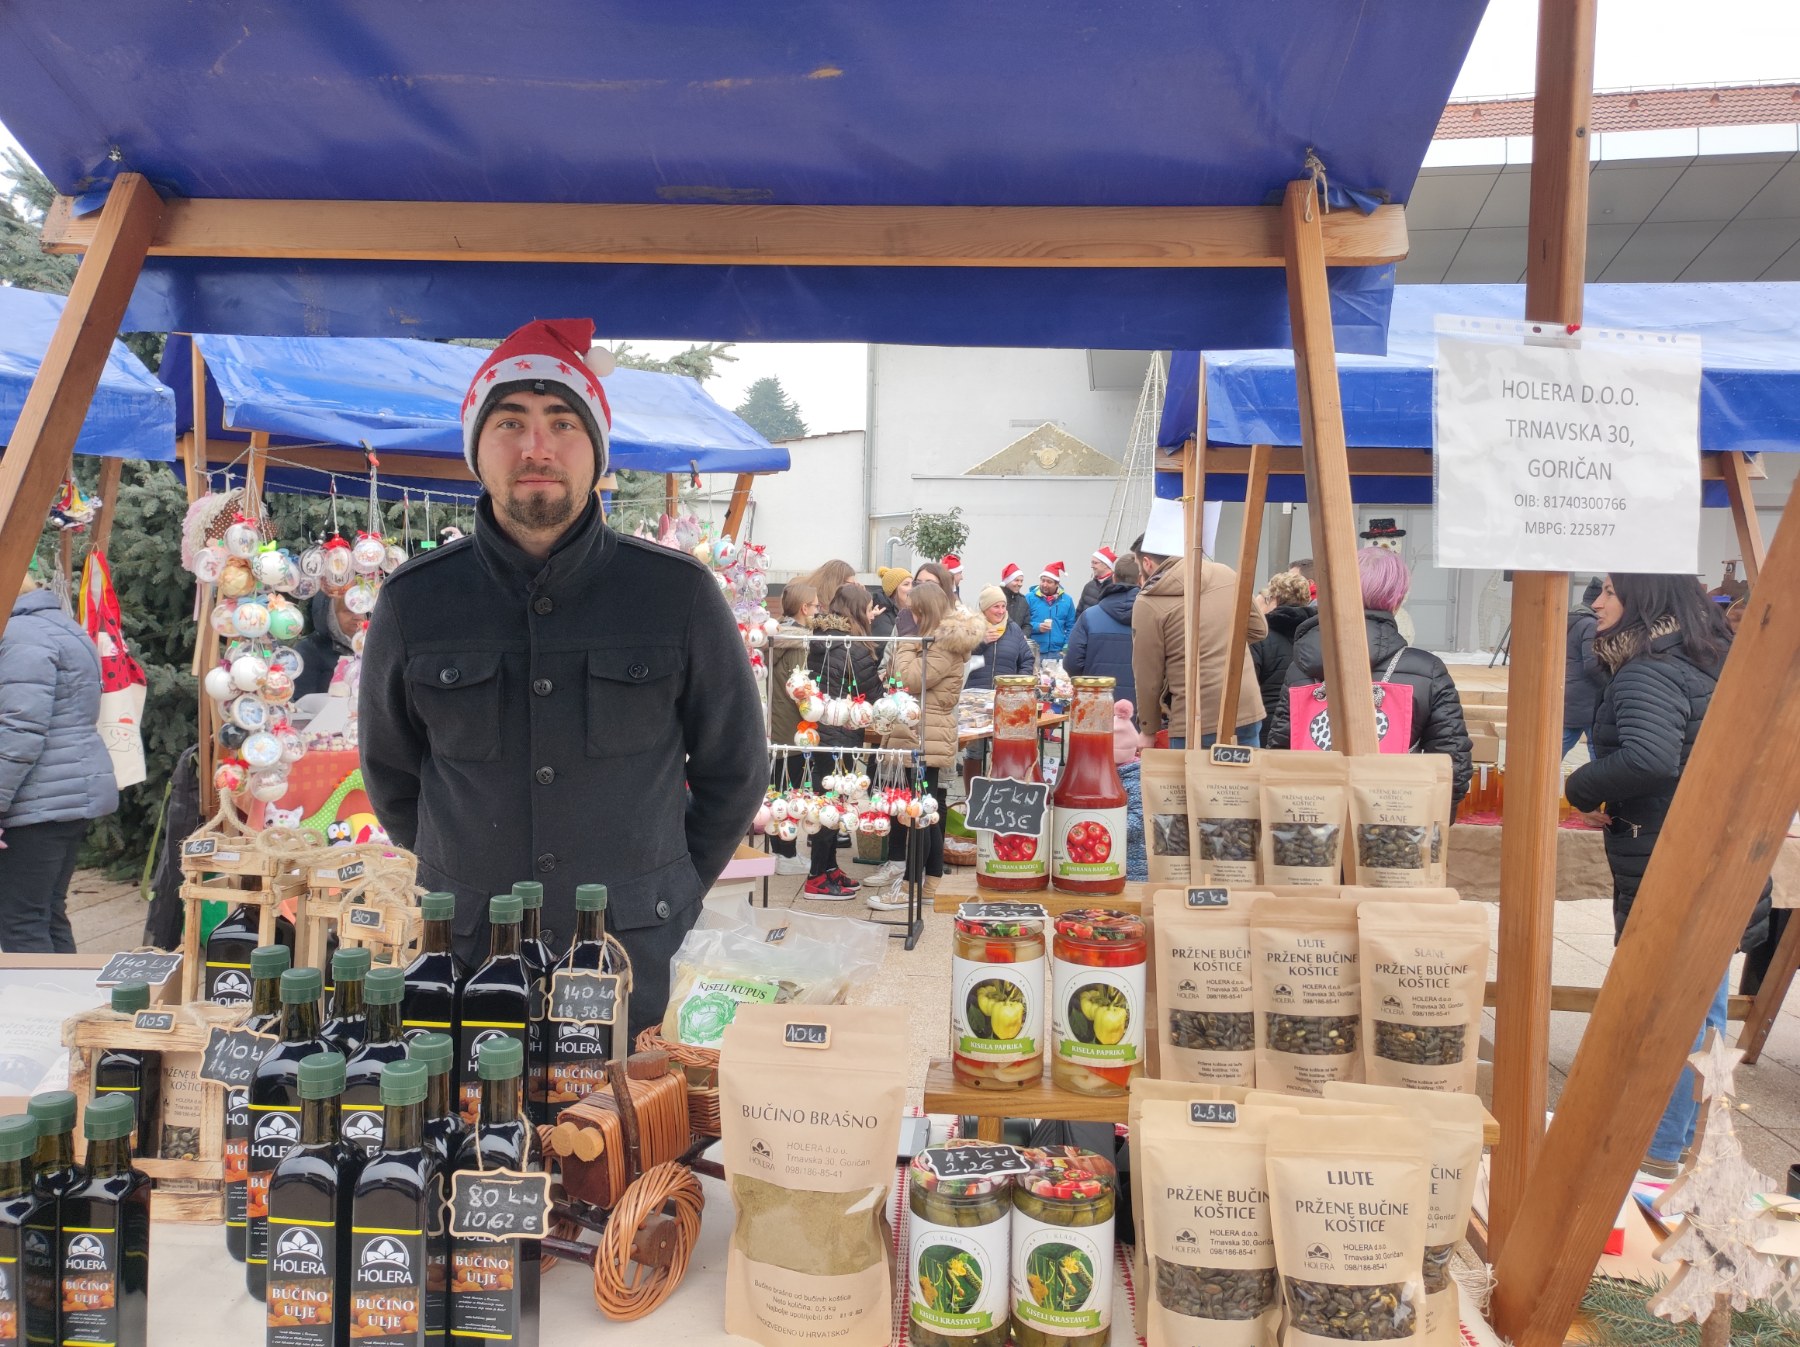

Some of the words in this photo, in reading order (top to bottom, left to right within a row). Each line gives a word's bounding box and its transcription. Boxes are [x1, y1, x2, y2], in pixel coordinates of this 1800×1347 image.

[1502, 380, 1574, 402] HOLERA
[1582, 384, 1639, 406] D.O.O.
[1505, 419, 1602, 442] TRNAVSKA
[1608, 425, 1634, 447] 30,
[1528, 457, 1612, 480] GORIČAN
[1514, 494, 1540, 508] OIB:
[1543, 496, 1626, 511] 81740300766
[1525, 521, 1566, 536] MBPG:
[1570, 522, 1615, 536] 225877
[1292, 814, 1319, 822] LJUTE
[1380, 814, 1407, 824] SLANE
[341, 863, 363, 878] 120
[1190, 892, 1204, 904] 15
[352, 911, 371, 924] 80
[1297, 939, 1326, 948] LJUTE
[1172, 947, 1216, 959] PRŽENE
[1220, 948, 1252, 960] BUČIN
[1267, 952, 1312, 963] PRŽENE
[1316, 951, 1358, 964] BUČINE
[1415, 948, 1445, 959] SLANE
[115, 957, 147, 968] 140
[1194, 961, 1242, 972] KOŠTICE
[1376, 962, 1422, 975] PRŽENE
[1426, 963, 1468, 975] BUČINE
[1289, 966, 1339, 976] KOŠTICE
[1398, 976, 1450, 988] KOŠTICE
[564, 984, 594, 1000] 140
[730, 984, 768, 1000] KUPUS
[138, 1014, 168, 1028] 105
[786, 1025, 806, 1041] 10
[215, 1037, 248, 1059] 110
[556, 1042, 602, 1054] HOLERA
[970, 1042, 994, 1050] KISELA
[995, 1042, 1022, 1050] PAPRIKA
[1072, 1046, 1095, 1055] KISELA
[1096, 1048, 1125, 1056] PAPRIKA
[554, 1065, 604, 1080] BUČINO
[565, 1081, 593, 1094] ULJE
[742, 1102, 805, 1124] BUČINO
[810, 1110, 878, 1130] BRAŠNO
[787, 1142, 823, 1152] HOLERA
[749, 1156, 776, 1172] HOLERA
[786, 1153, 822, 1165] Trnavska
[1327, 1170, 1374, 1186] LJUTE
[1431, 1164, 1462, 1180] ČINE
[469, 1184, 500, 1208] 80
[1167, 1186, 1223, 1202] PRŽENE
[1228, 1188, 1270, 1203] BUČIN
[1194, 1204, 1256, 1220] KOŠTICE
[1296, 1198, 1355, 1215] PRŽENE
[1358, 1200, 1409, 1216] BUČINE
[462, 1212, 514, 1230] 10,62
[522, 1216, 538, 1230] €
[1324, 1216, 1386, 1233] KOŠTICE
[1210, 1238, 1240, 1246] Trnavska
[1210, 1248, 1257, 1256] 098/186-85-41
[1344, 1253, 1374, 1261] Trnavska
[66, 1259, 107, 1270] HOLERA
[273, 1259, 326, 1274] HOLERA
[456, 1255, 508, 1270] BUČINO
[1304, 1261, 1335, 1270] HOLERA
[357, 1269, 413, 1284] HOLERA
[466, 1272, 497, 1286] ULJE
[65, 1280, 109, 1291] BUČINO
[74, 1294, 100, 1304] ULJE
[272, 1288, 328, 1302] BUČINO
[356, 1296, 414, 1313] BUČINO
[284, 1305, 316, 1319] ULJE
[919, 1310, 940, 1322] KISELI
[940, 1316, 980, 1326] KRASTAVCI
[1026, 1306, 1048, 1320] KISELI
[1050, 1314, 1090, 1324] KRASTAVCI
[368, 1314, 402, 1329] ULJE
